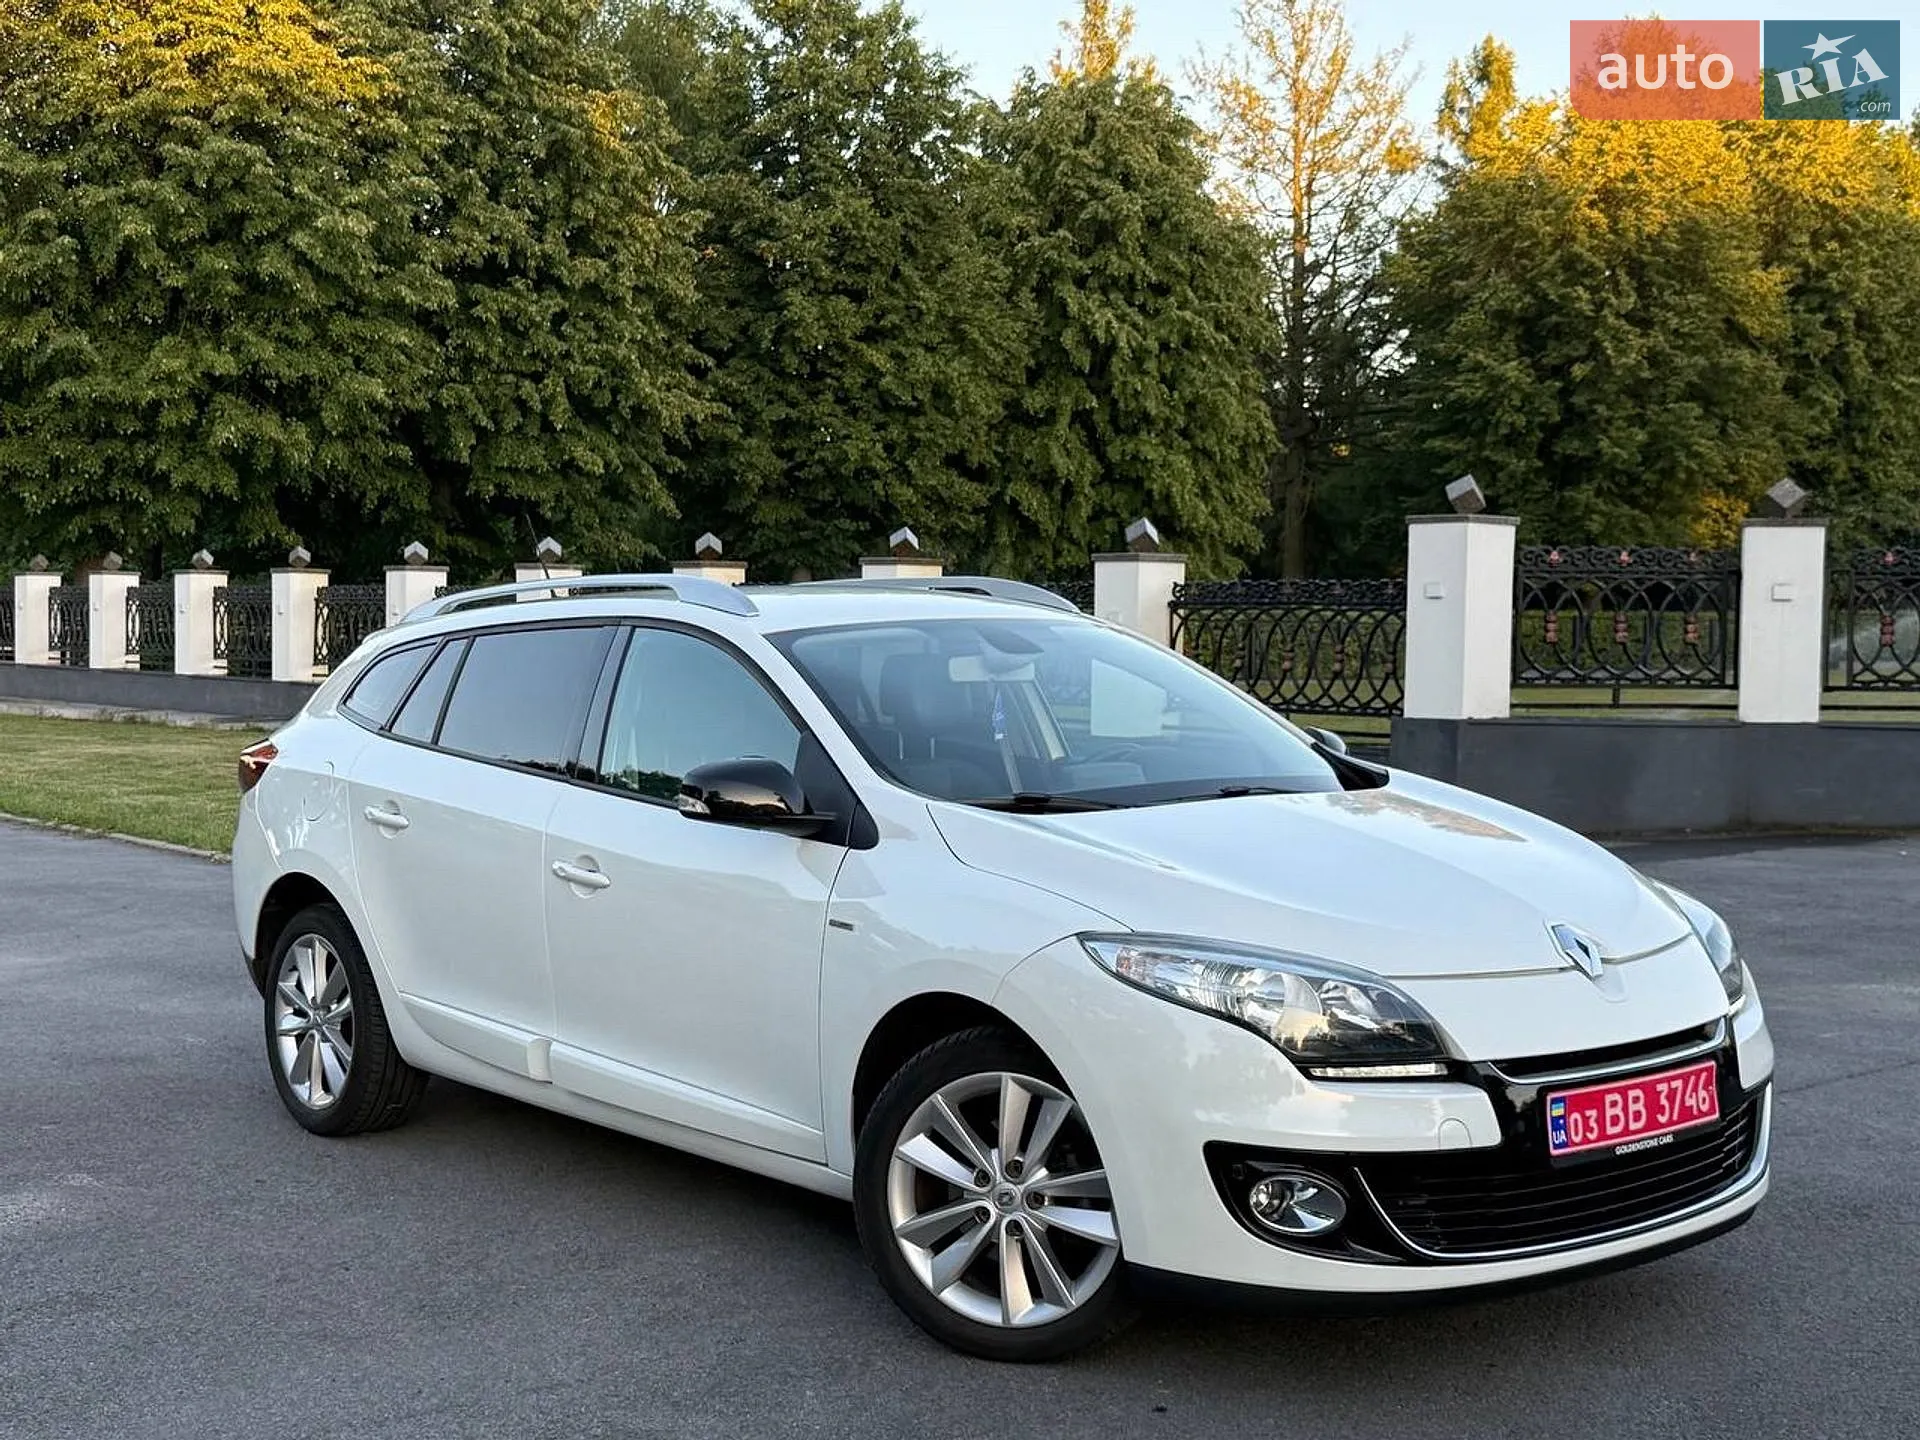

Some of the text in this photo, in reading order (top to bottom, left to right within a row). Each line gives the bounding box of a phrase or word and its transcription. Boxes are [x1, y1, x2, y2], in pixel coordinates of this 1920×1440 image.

[1569, 1072, 1709, 1142] 03 BB 3746
[1552, 1130, 1567, 1144] UA
